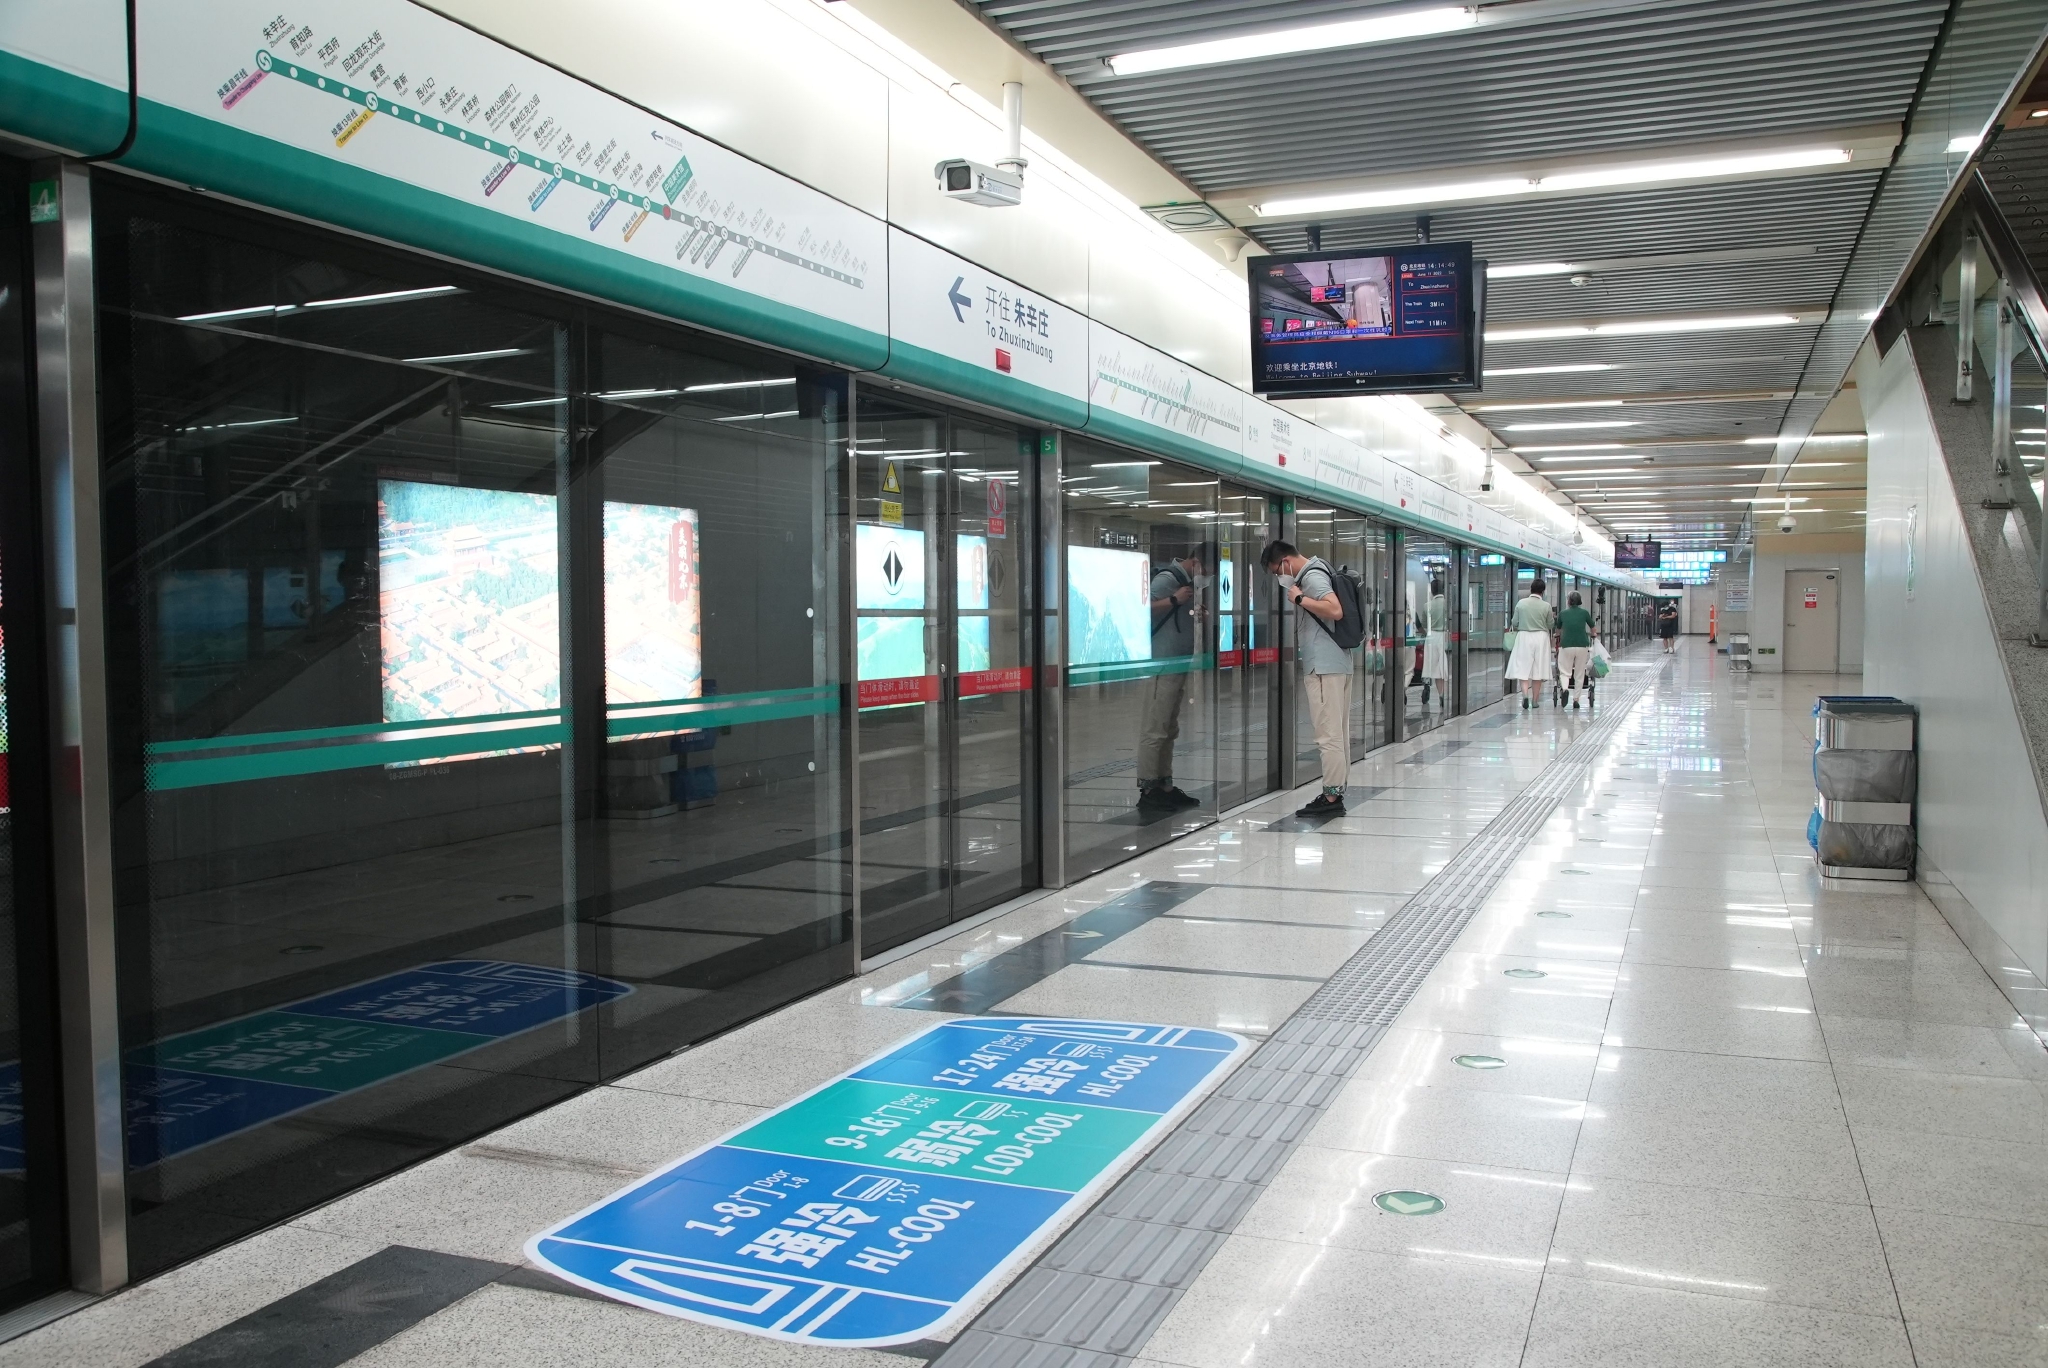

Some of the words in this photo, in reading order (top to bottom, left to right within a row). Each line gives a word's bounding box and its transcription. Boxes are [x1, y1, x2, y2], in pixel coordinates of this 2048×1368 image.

[262, 14, 288, 40] 朱辛庄
[288, 25, 314, 51] 育知路
[317, 36, 341, 61] 平西府
[342, 29, 382, 72] 回龙观东大街
[216, 67, 249, 100] 换乘昌平线
[370, 64, 386, 82] 霍营
[392, 72, 408, 92] 育新
[414, 77, 436, 100] 西小口
[439, 86, 458, 109] 永泰庄
[461, 94, 480, 118] 林萃桥
[484, 84, 517, 122] 森林公园南门
[509, 94, 540, 132] 奥林匹克公园
[331, 108, 359, 138] 换乘13号线
[533, 116, 554, 142] 奥体中心
[480, 162, 503, 189] 换乘15号线
[38, 188, 51, 214] 4
[986, 286, 1010, 322] 开往
[1014, 298, 1049, 338] 朱辛庄
[986, 320, 996, 338] To
[999, 326, 1053, 363] Zhuxinzhuang
[1045, 440, 1051, 451] 5
[1287, 503, 1291, 511] 6
[998, 1034, 1017, 1046] Door
[1016, 1036, 1036, 1048] 17-24
[932, 1040, 1020, 1086] 17-24门
[1076, 1054, 1159, 1098] HL-COOL
[992, 1058, 1090, 1095] 强冷
[893, 1092, 921, 1106] Door
[914, 1096, 940, 1108] 9-16
[825, 1104, 922, 1150] 9-16门
[884, 1120, 1000, 1168] 弱冷
[971, 1112, 1084, 1176] LOD-COOL
[753, 1169, 791, 1188] Door
[783, 1176, 810, 1189] 1-8
[685, 1185, 787, 1237] 1-8门
[736, 1202, 880, 1269] 强冷
[846, 1198, 976, 1274] HL-COOL
